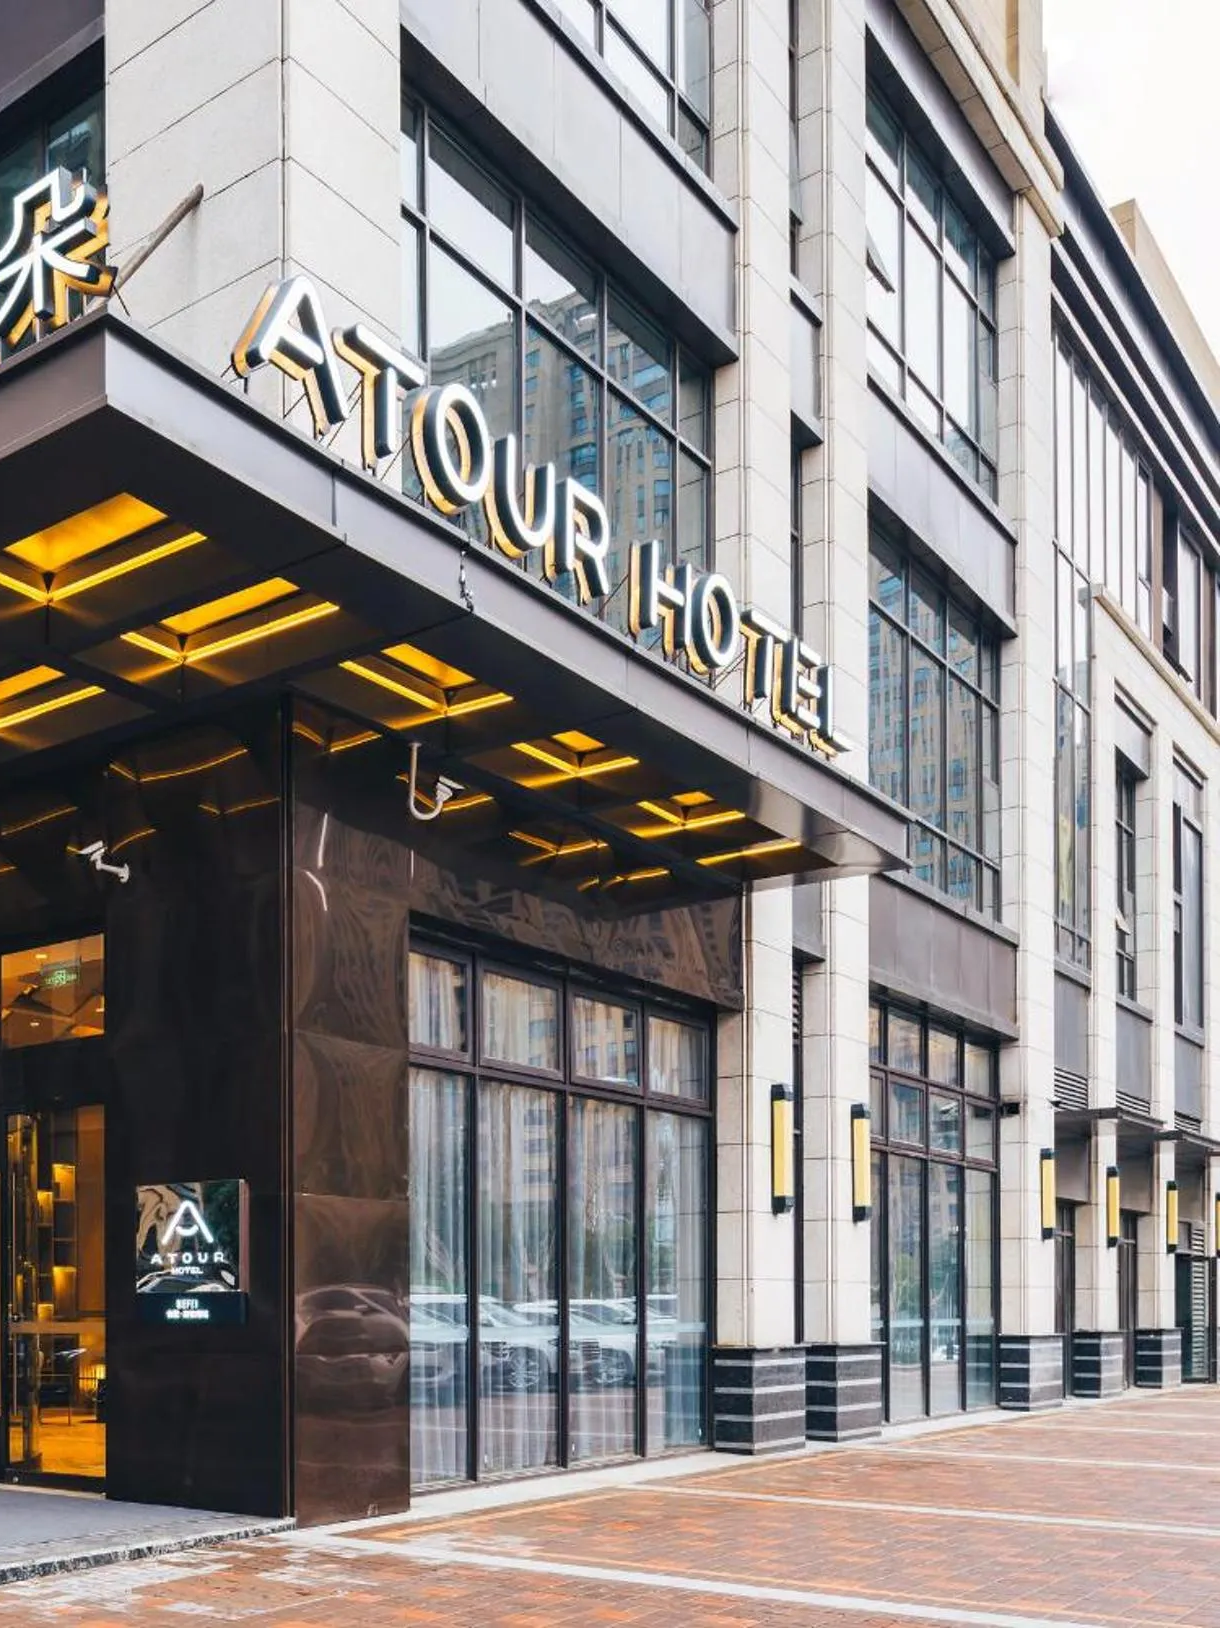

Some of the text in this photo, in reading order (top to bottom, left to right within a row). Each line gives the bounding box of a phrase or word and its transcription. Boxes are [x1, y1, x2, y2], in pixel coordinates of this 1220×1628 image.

[232, 274, 852, 757] ATOUR HOTEL
[150, 1252, 225, 1265] ATOUR
[171, 1266, 204, 1275] HOTEL
